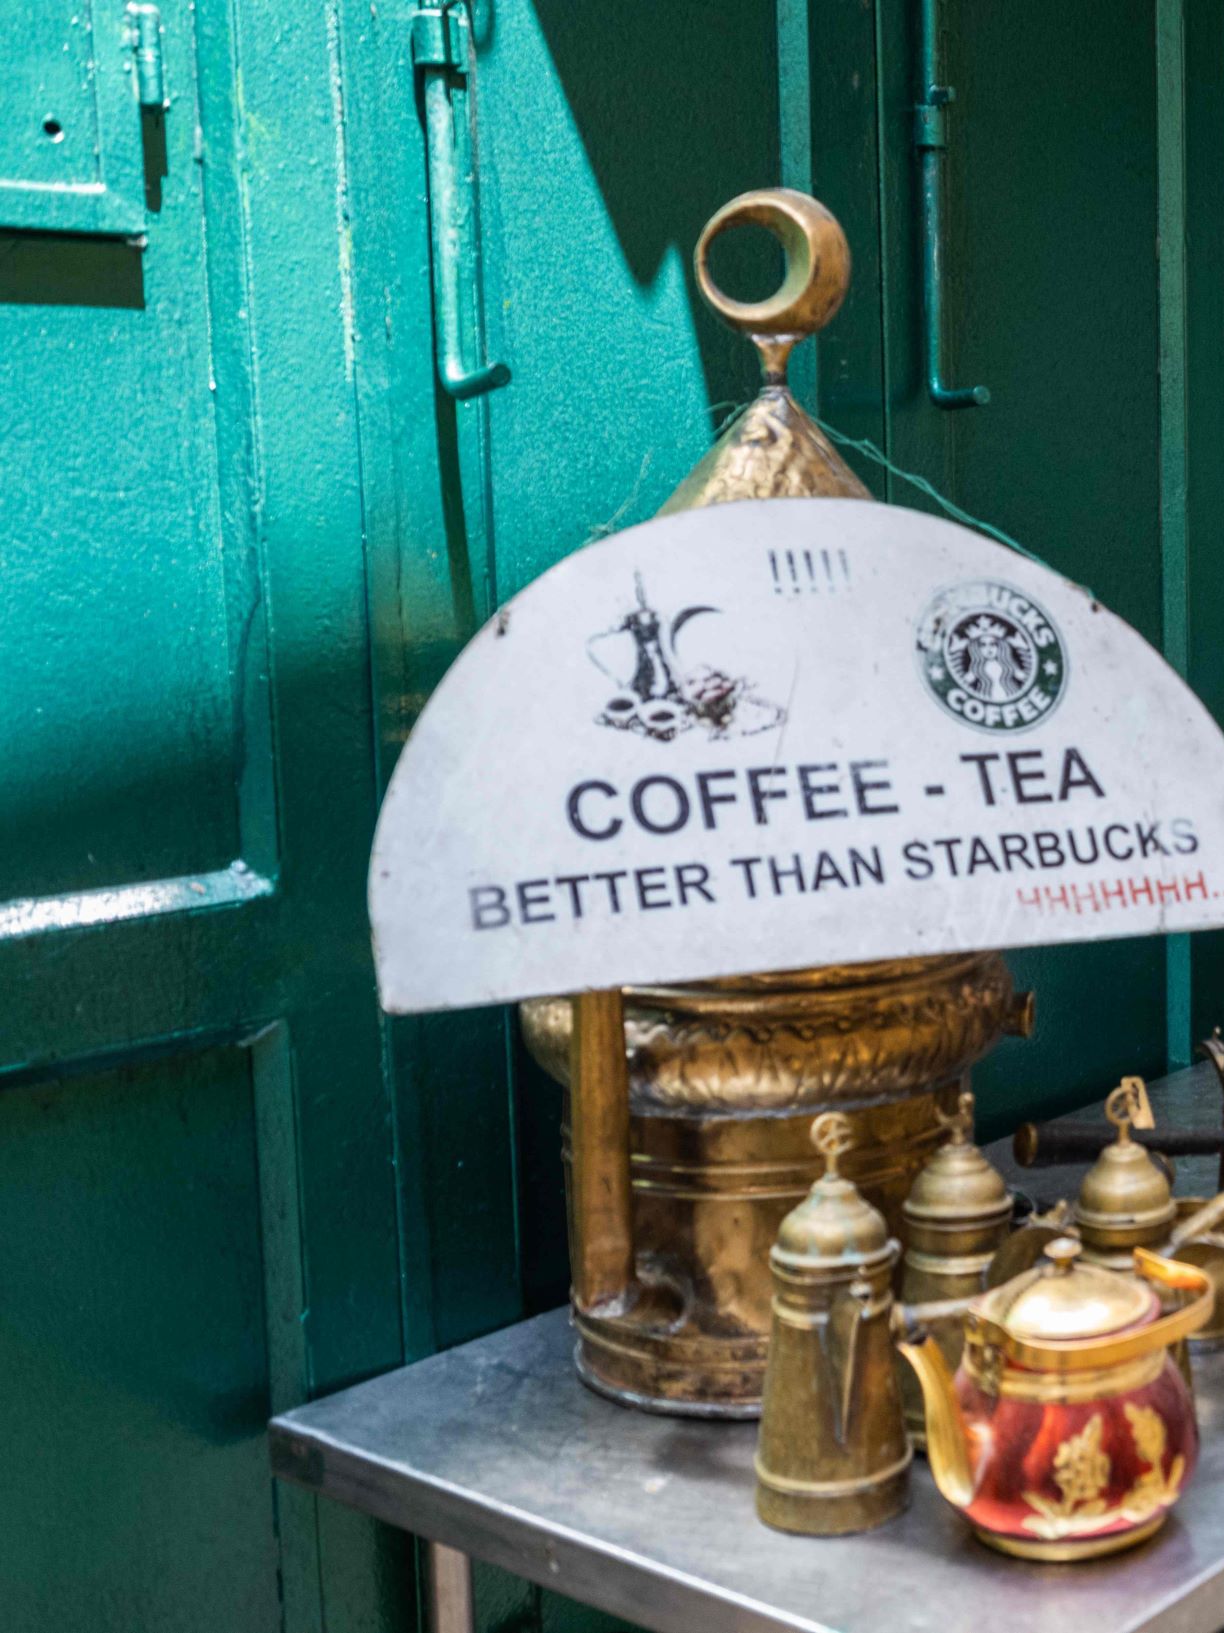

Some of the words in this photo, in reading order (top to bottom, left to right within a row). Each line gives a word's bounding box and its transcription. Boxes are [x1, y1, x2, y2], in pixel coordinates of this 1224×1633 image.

[947, 685, 1052, 728] COFFEE
[566, 759, 899, 841] COFFEE
[960, 748, 1106, 807] TEA
[468, 863, 715, 931] BETTER
[730, 846, 886, 899] THAN
[903, 818, 1198, 880] STARBUCKS
